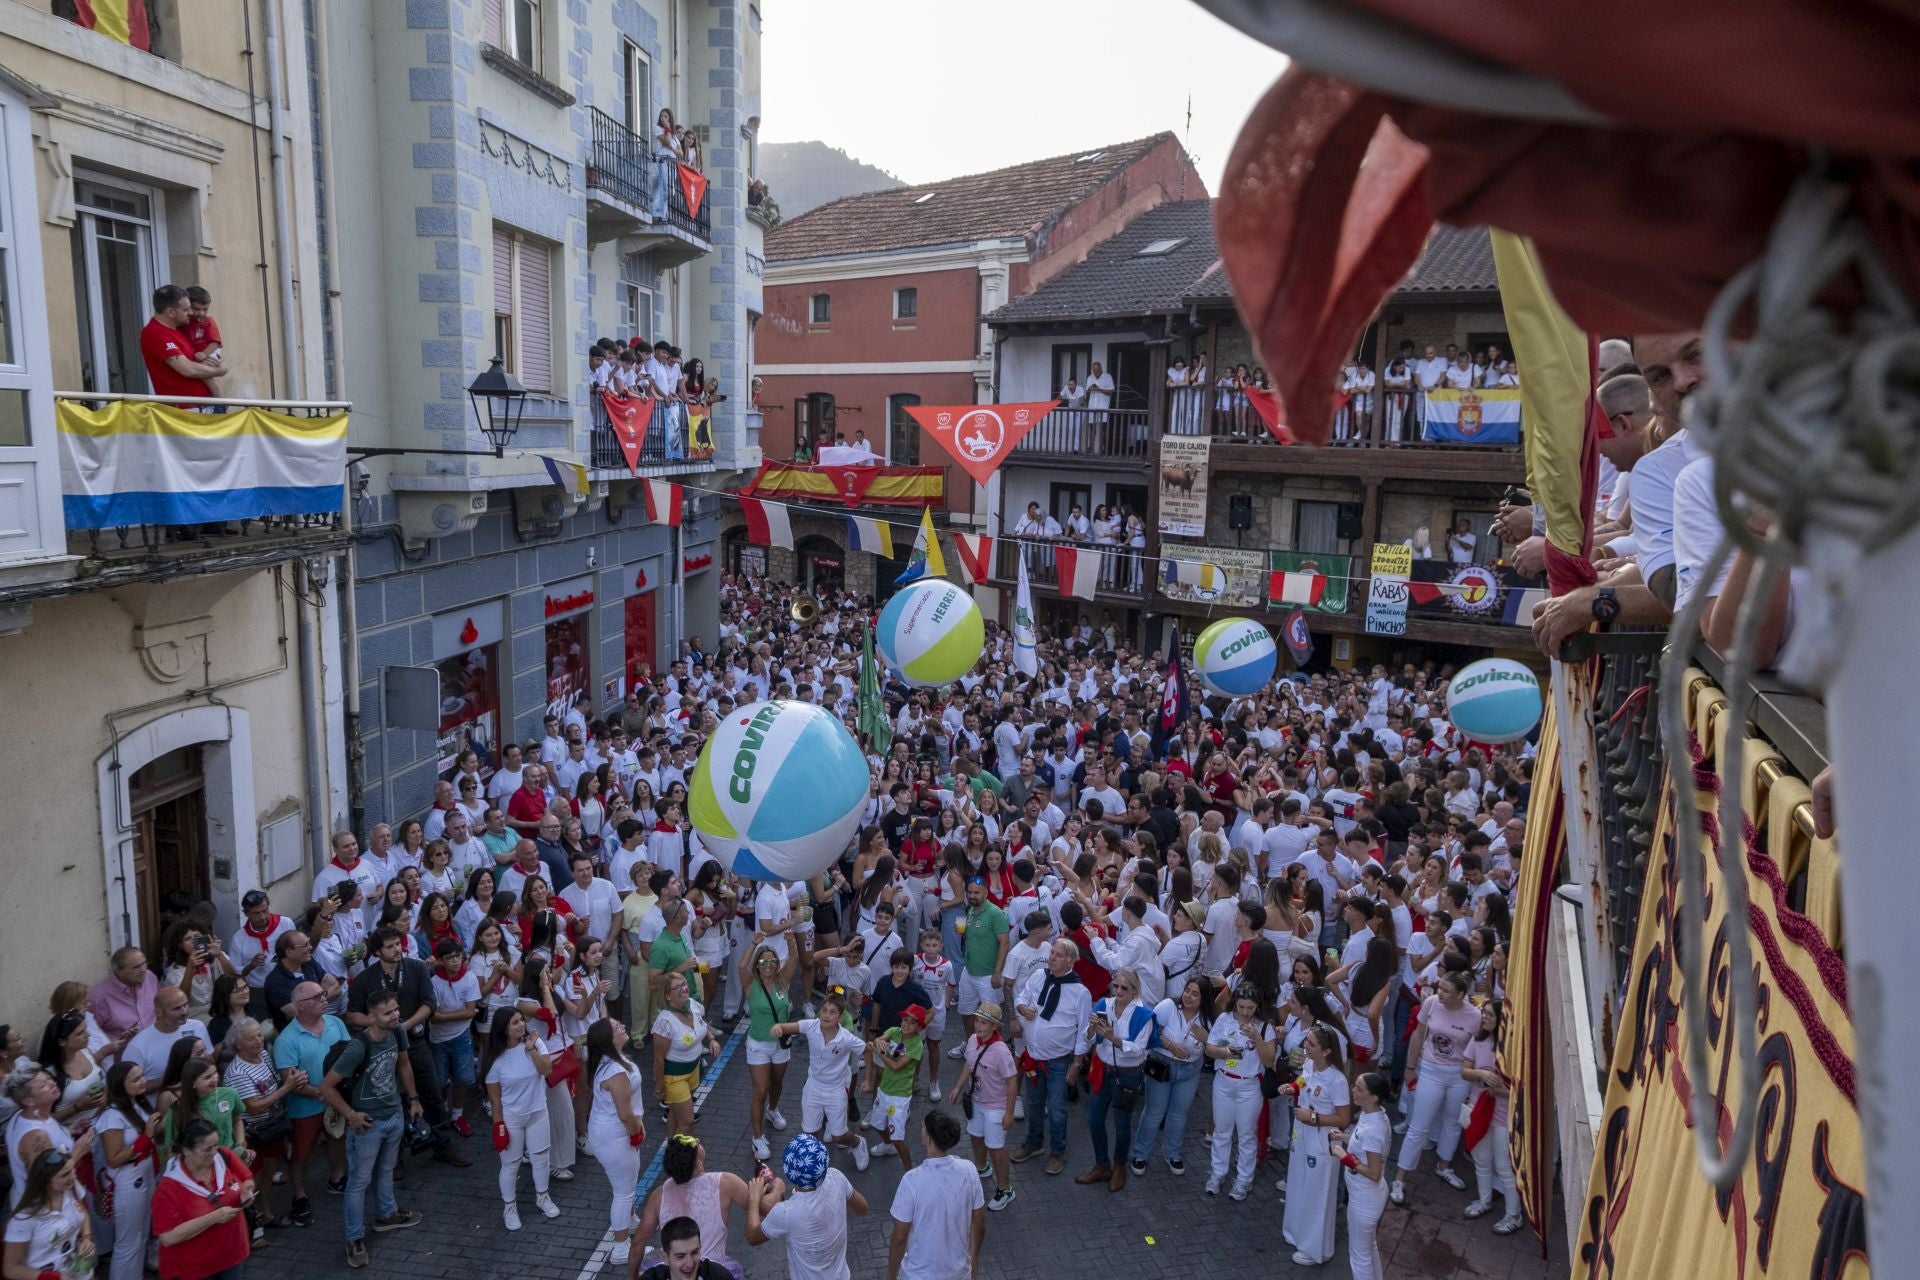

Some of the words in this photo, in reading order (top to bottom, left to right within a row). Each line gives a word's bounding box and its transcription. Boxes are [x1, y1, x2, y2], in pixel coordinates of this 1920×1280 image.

[1162, 441, 1178, 449] TORO
[1178, 442, 1187, 450] DE
[1374, 544, 1410, 555] TORTILLA
[1372, 556, 1409, 565] CROQUETAS
[1373, 564, 1408, 574] NUGGETS
[1372, 577, 1408, 604] RABAS
[1368, 601, 1388, 609] GRAN
[904, 590, 933, 635] Supermercados
[1454, 668, 1537, 695] COVIRAN
